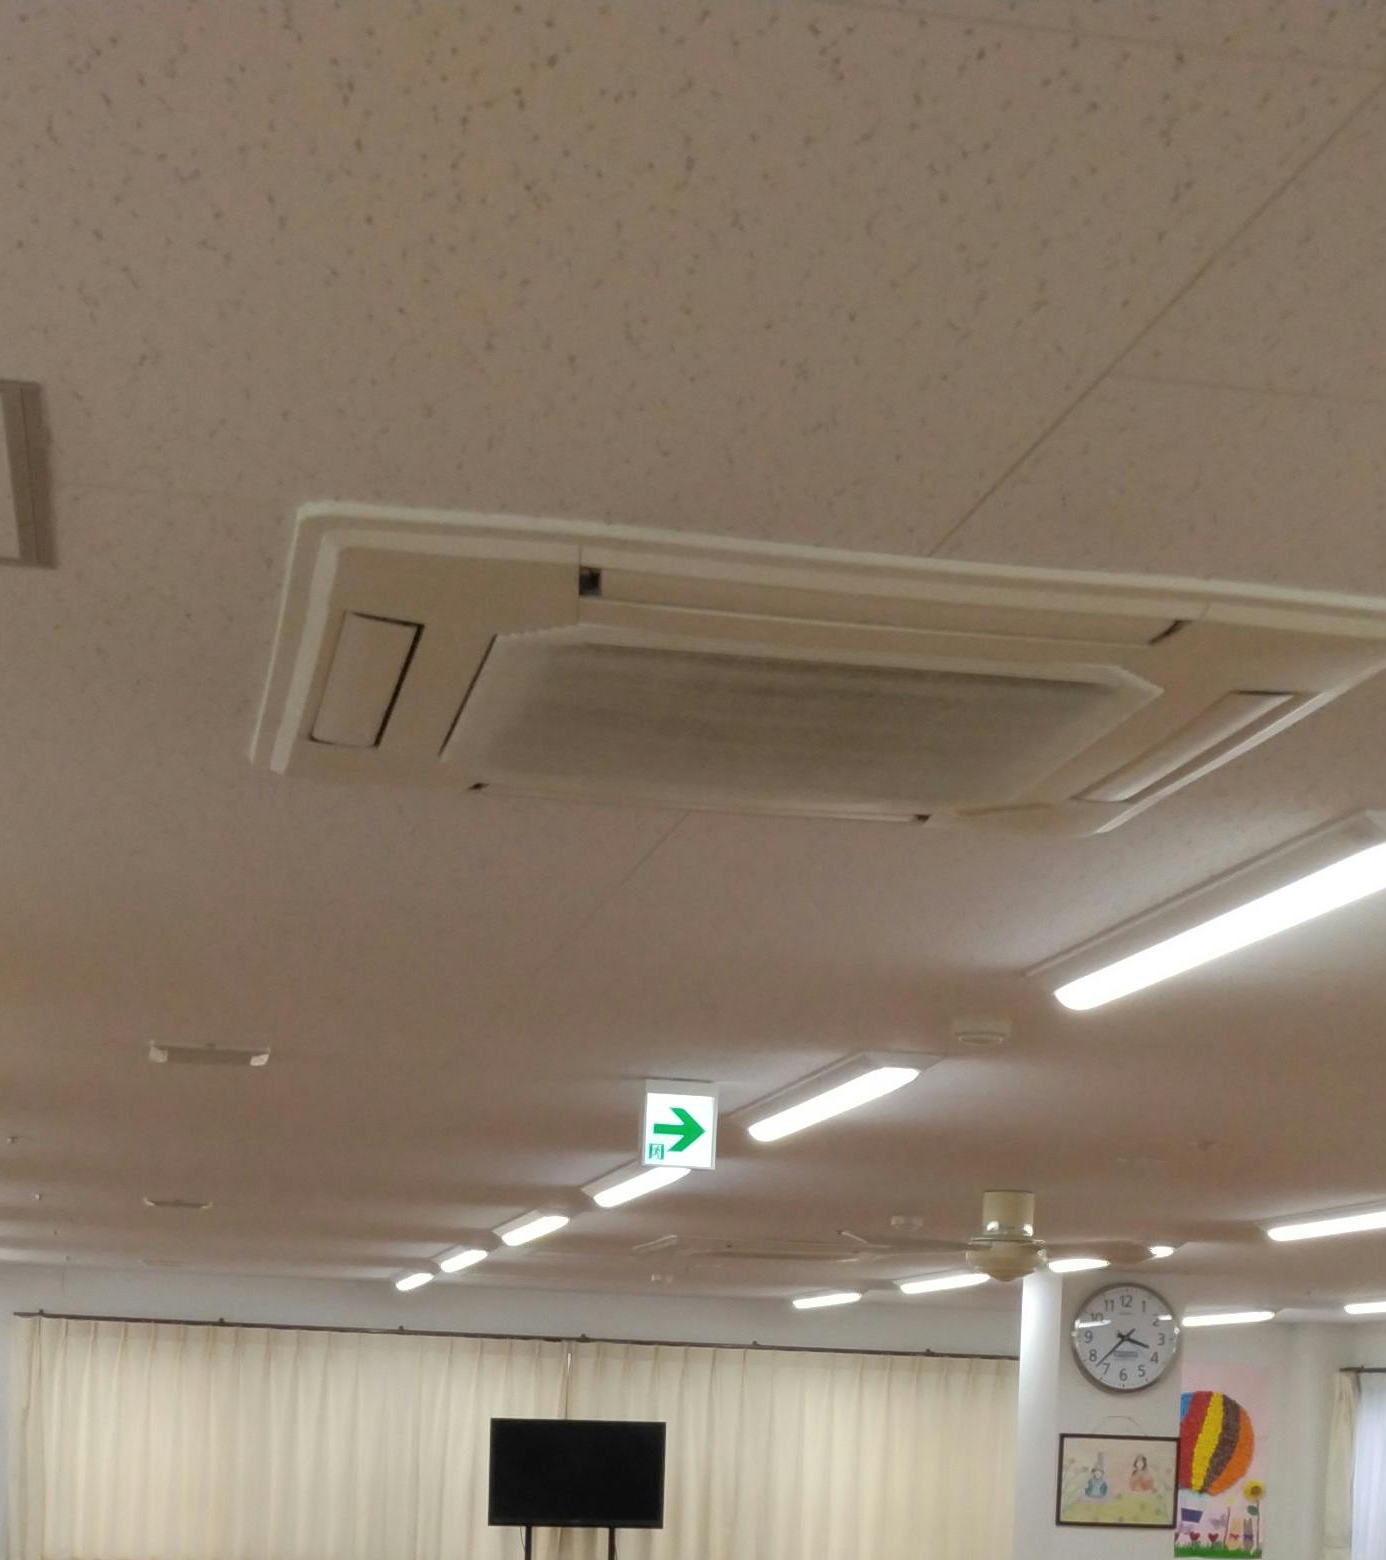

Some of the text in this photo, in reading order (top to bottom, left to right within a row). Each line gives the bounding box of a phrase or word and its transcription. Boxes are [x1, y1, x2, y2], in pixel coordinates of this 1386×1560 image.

[1104, 1299, 1114, 1312] 11
[1120, 1295, 1133, 1308] 12
[1141, 1300, 1147, 1313] 1
[1084, 1330, 1093, 1344] 9
[1157, 1333, 1166, 1346] 3
[1088, 1349, 1098, 1362] 8
[1150, 1351, 1159, 1364] 4
[1103, 1362, 1111, 1375] 7
[1119, 1368, 1128, 1381] 6
[1137, 1364, 1146, 1378] 5
